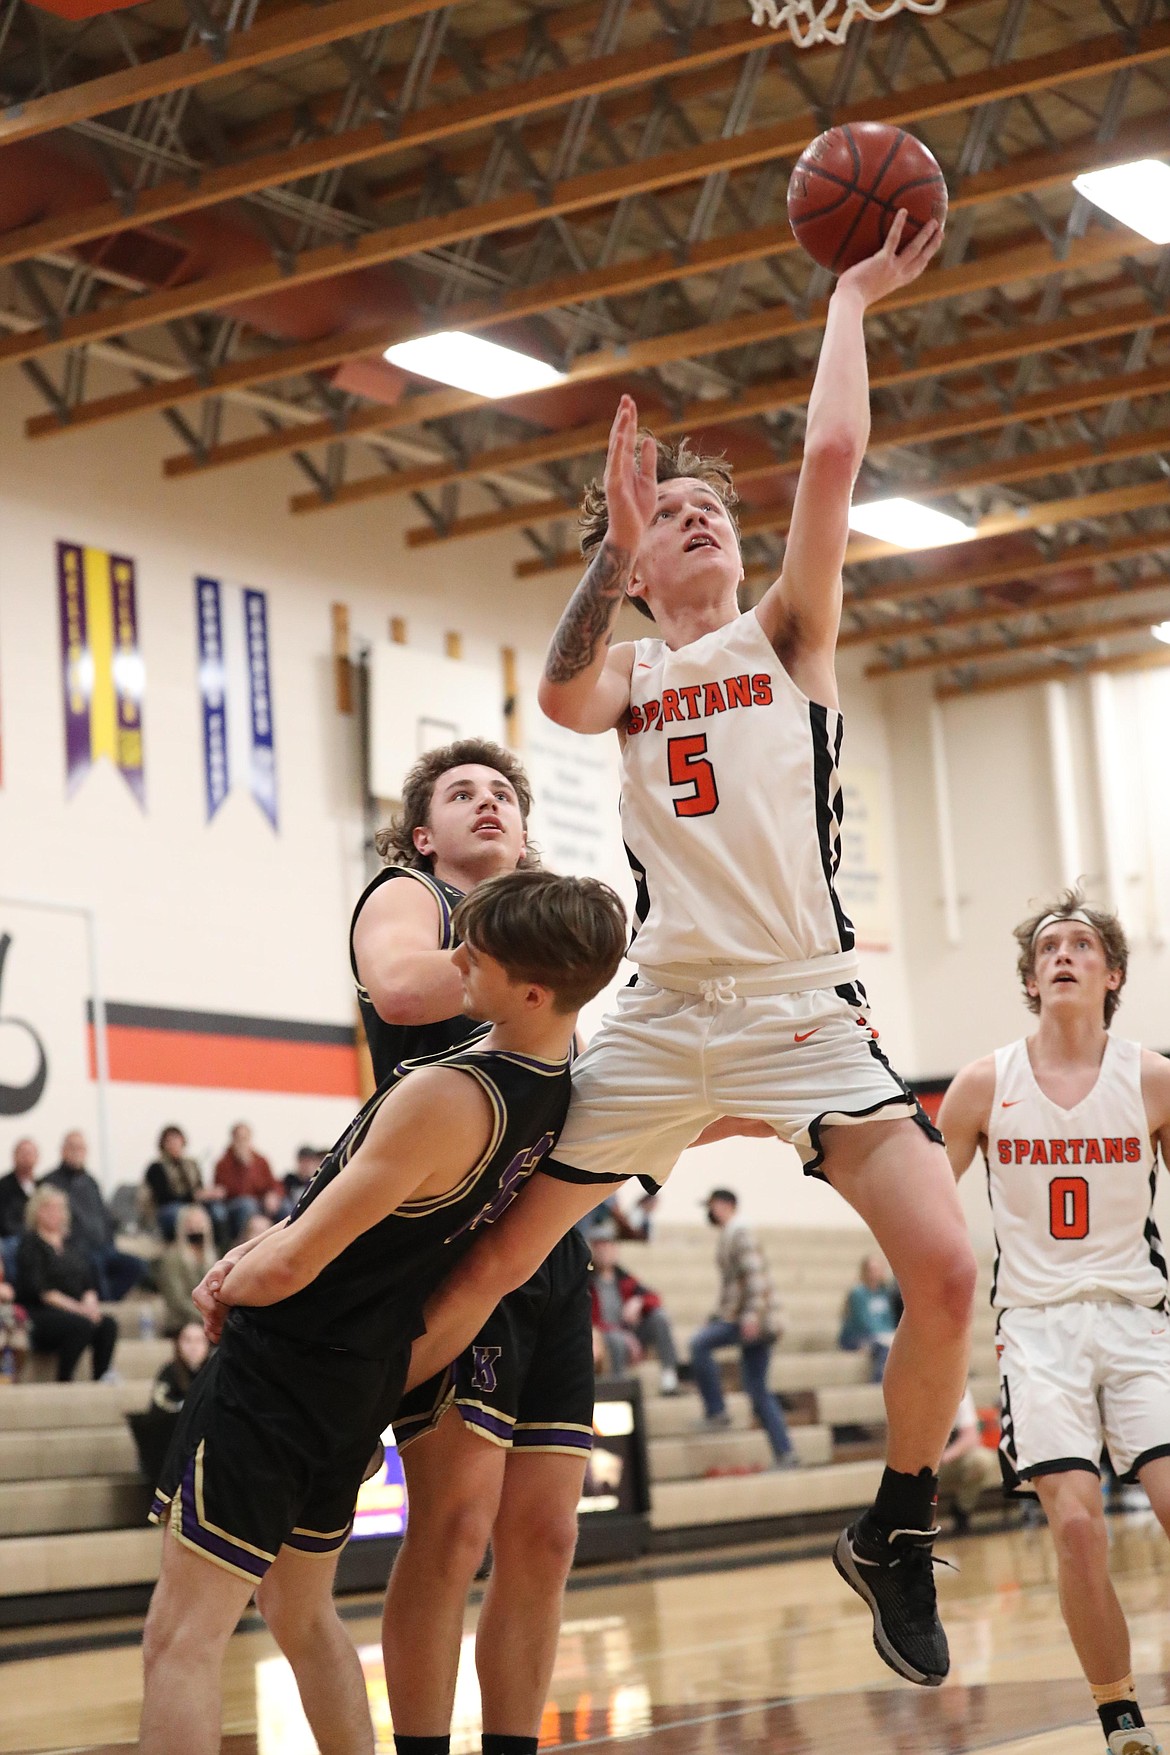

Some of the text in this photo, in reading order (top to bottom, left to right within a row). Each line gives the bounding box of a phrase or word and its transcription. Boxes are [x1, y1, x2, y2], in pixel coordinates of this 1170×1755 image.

[667, 732, 719, 817] 5
[997, 1137, 1141, 1165] SPARTANS
[1049, 1176, 1089, 1240] 0
[472, 1346, 501, 1392] K
